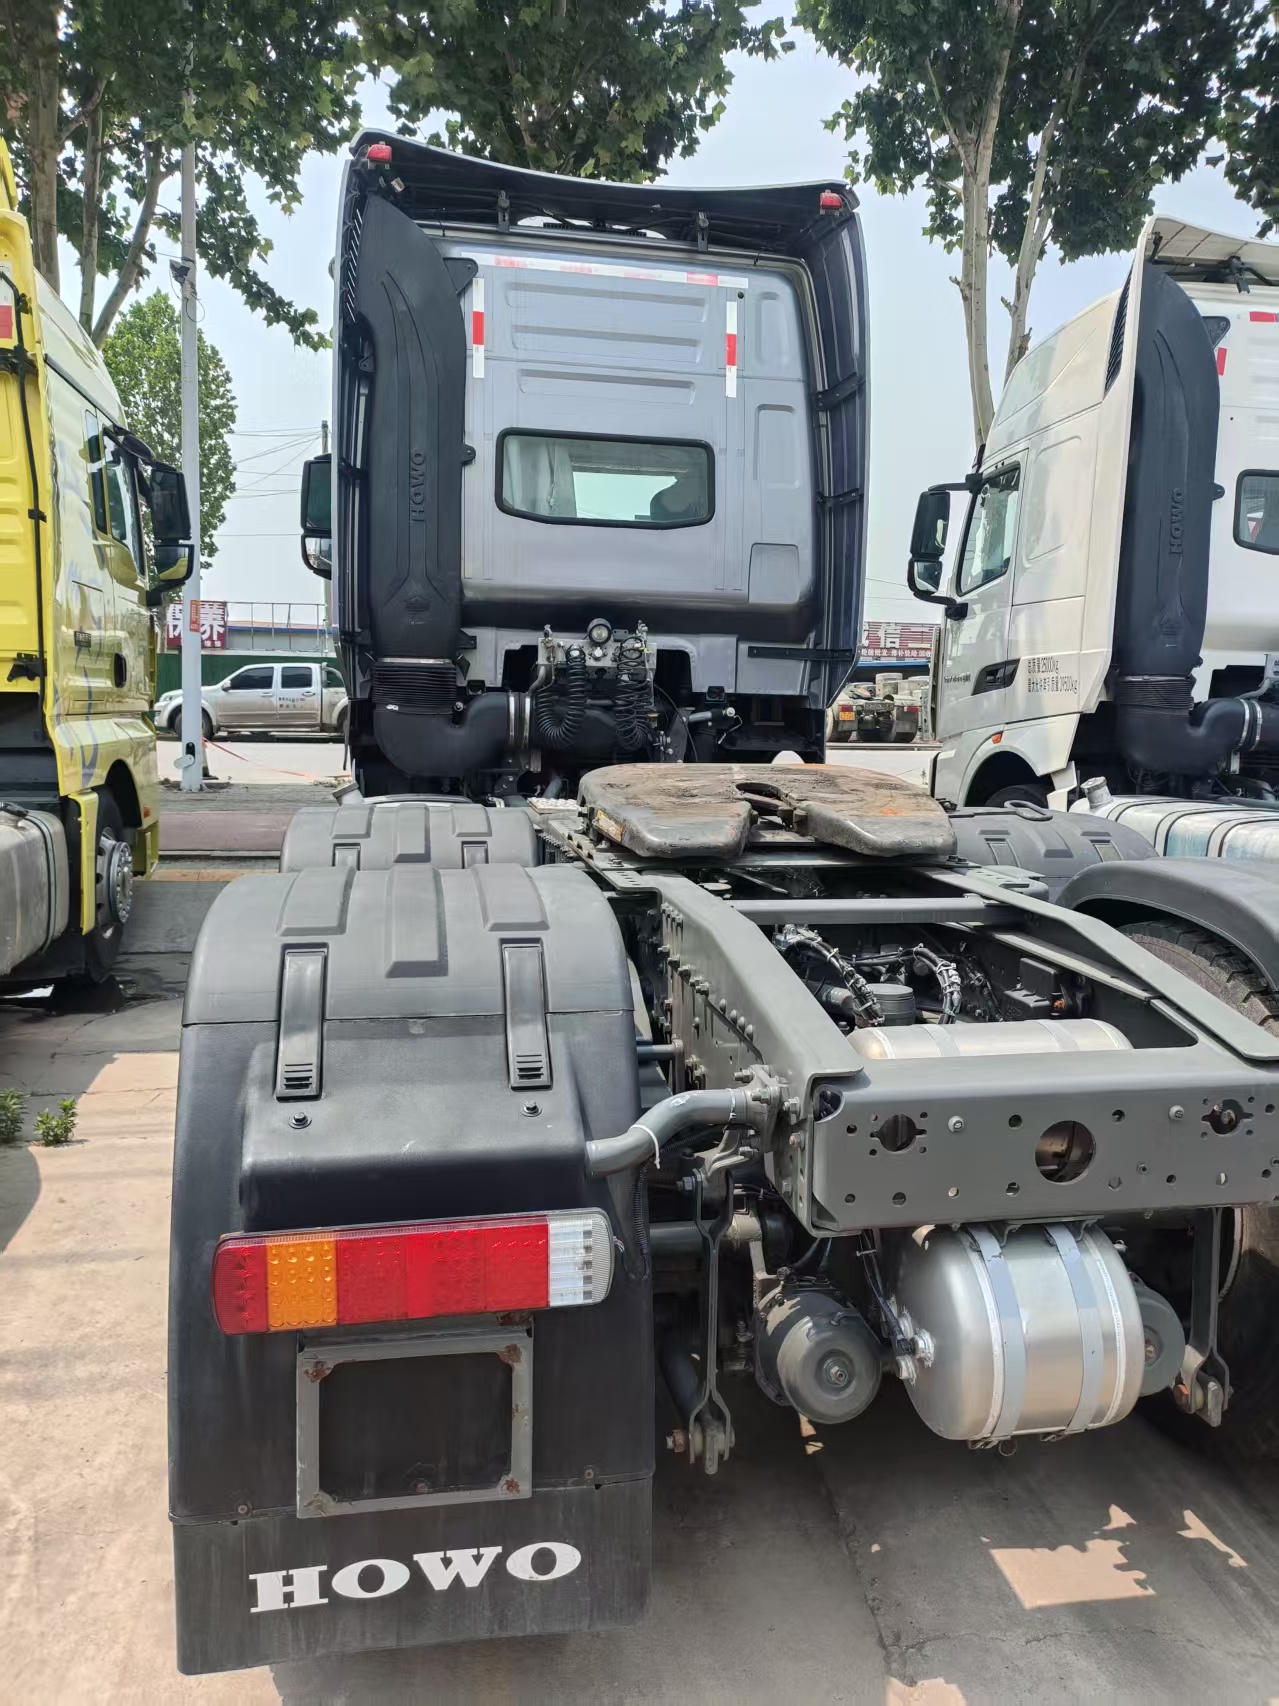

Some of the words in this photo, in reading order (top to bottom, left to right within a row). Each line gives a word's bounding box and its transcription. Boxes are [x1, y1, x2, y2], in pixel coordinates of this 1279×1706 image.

[410, 447, 425, 523] HOWO
[1168, 487, 1184, 555] HOWO
[248, 1541, 582, 1613] HOWO
